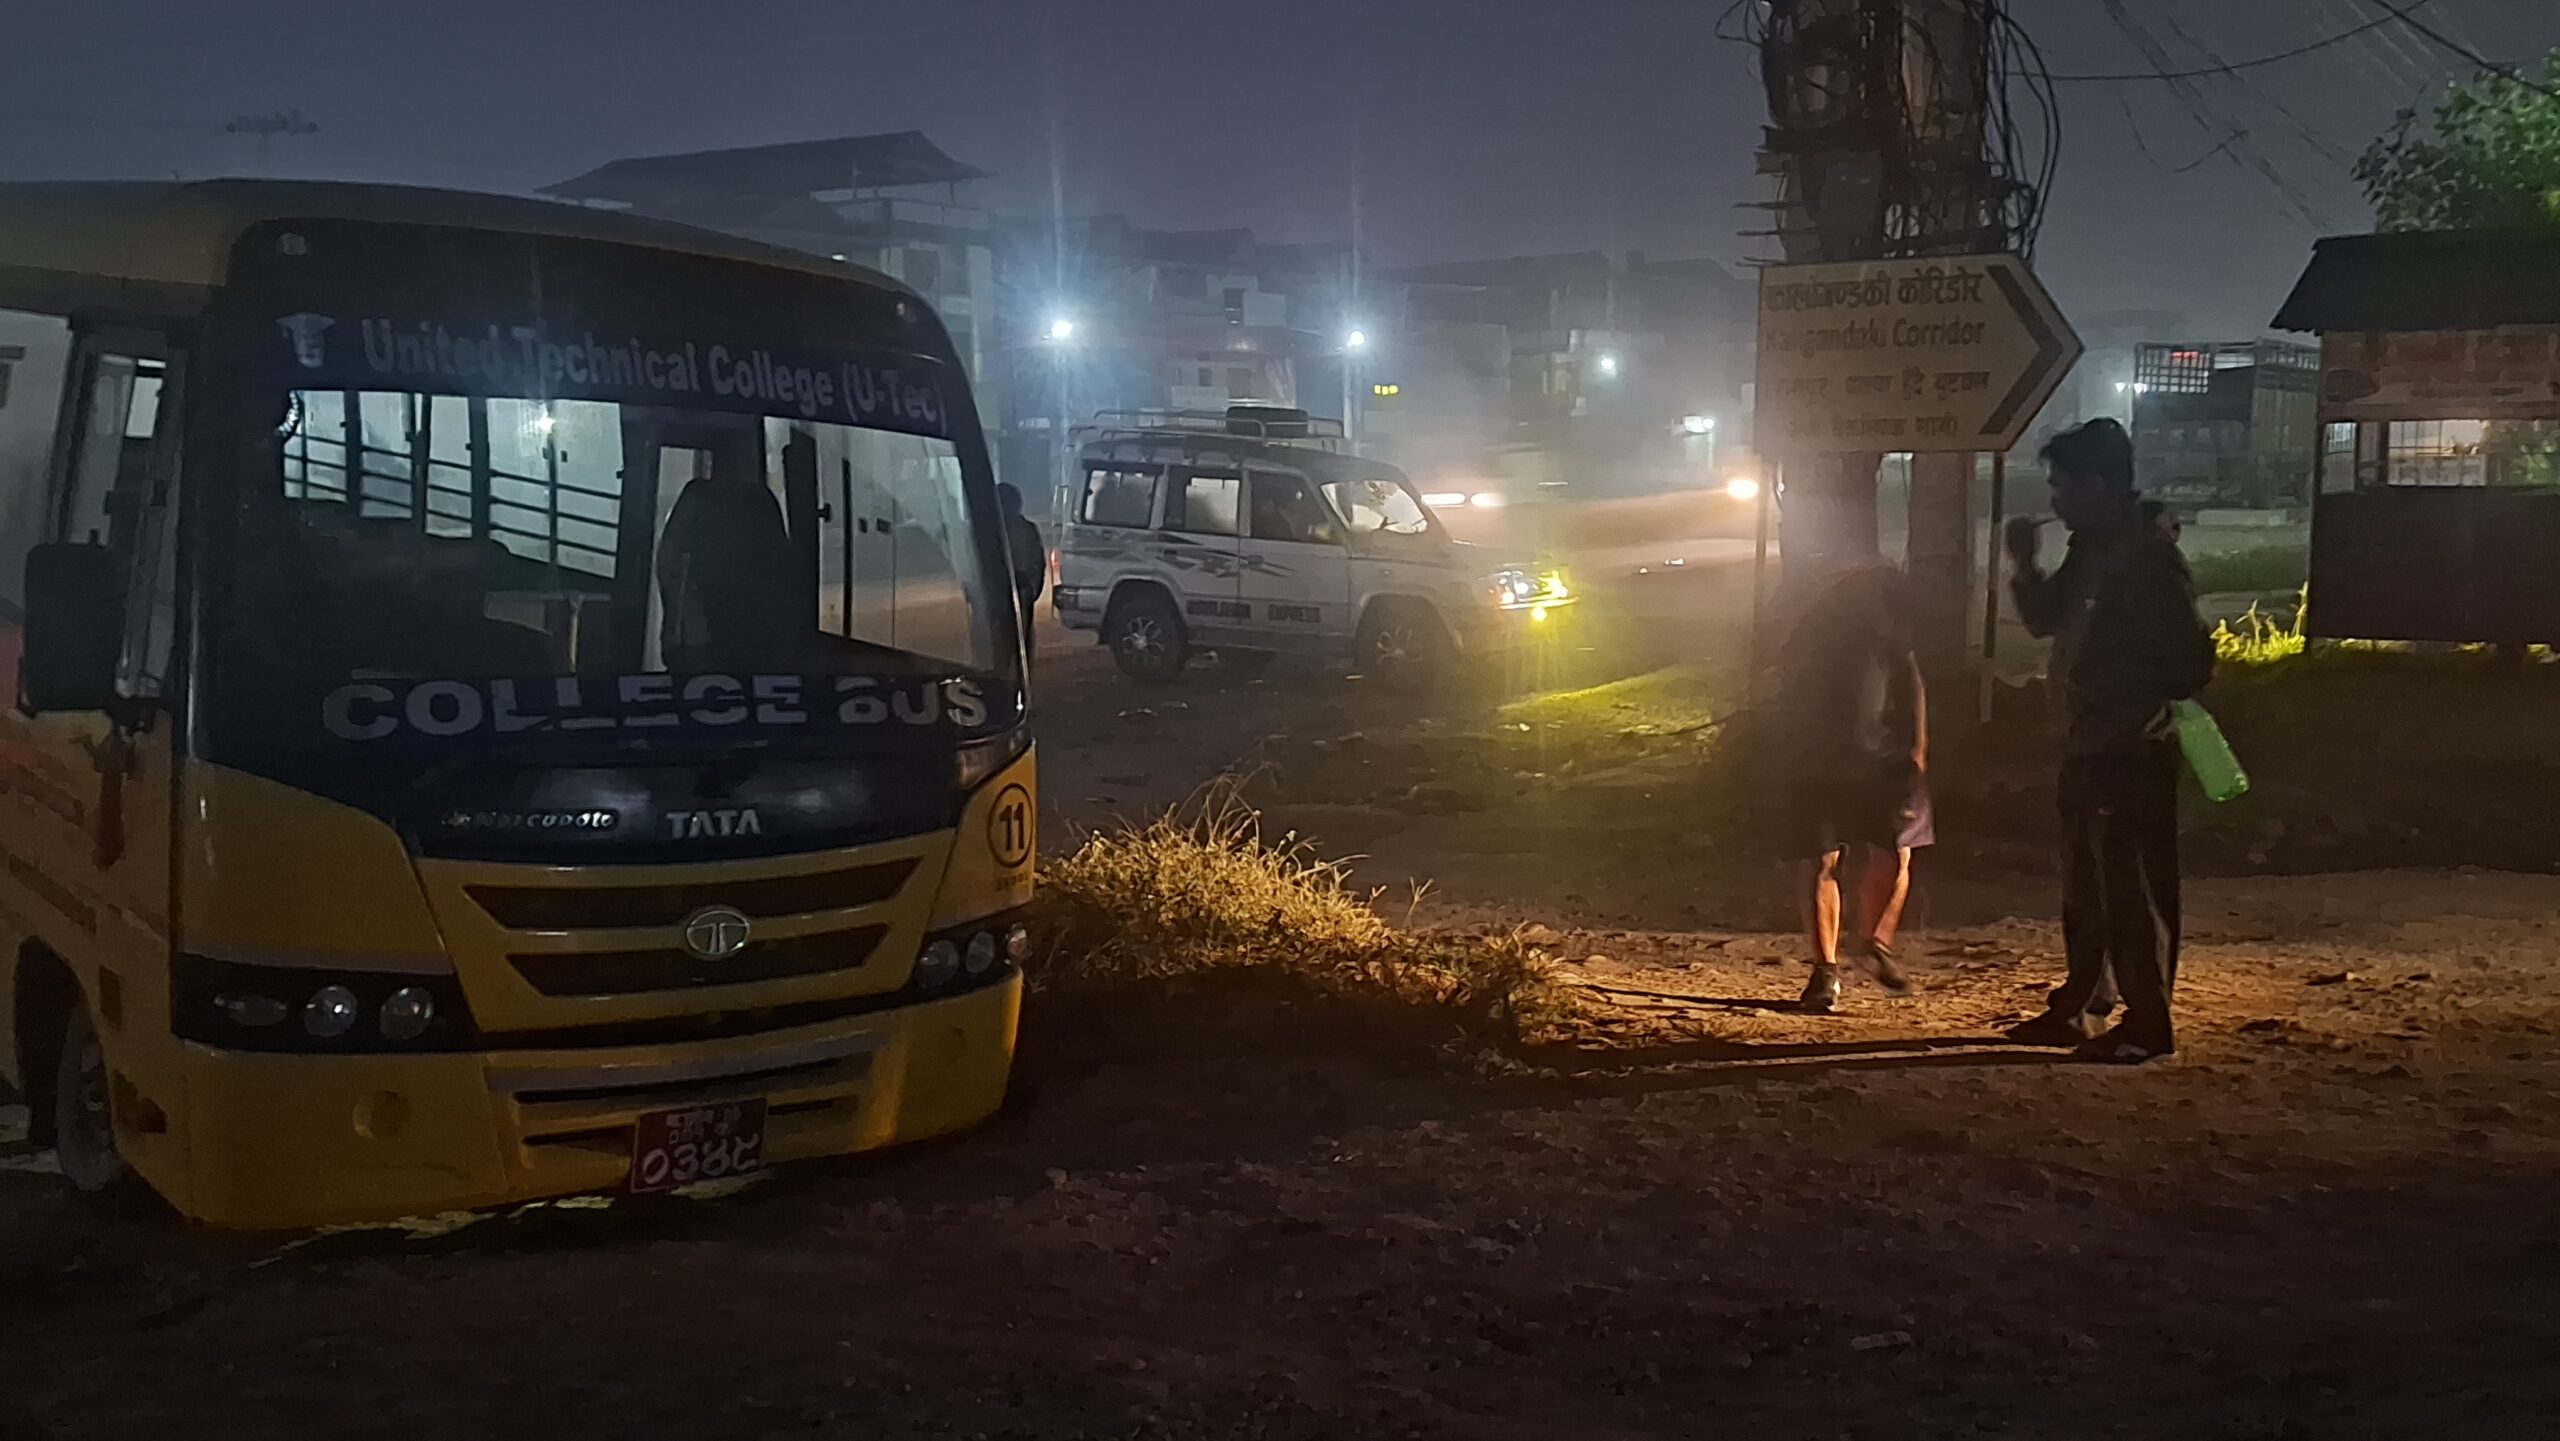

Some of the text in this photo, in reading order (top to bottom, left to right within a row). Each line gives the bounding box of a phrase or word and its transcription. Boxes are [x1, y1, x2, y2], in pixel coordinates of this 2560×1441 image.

[1897, 265, 1984, 305] कोरिडोर
[1765, 314, 1985, 358] Kagandaki Corridor
[360, 318, 948, 434] United Technical College (U-Tec)
[321, 674, 988, 740] COLLEGE BUS
[665, 809, 764, 840] TATA
[998, 801, 1025, 852] 11
